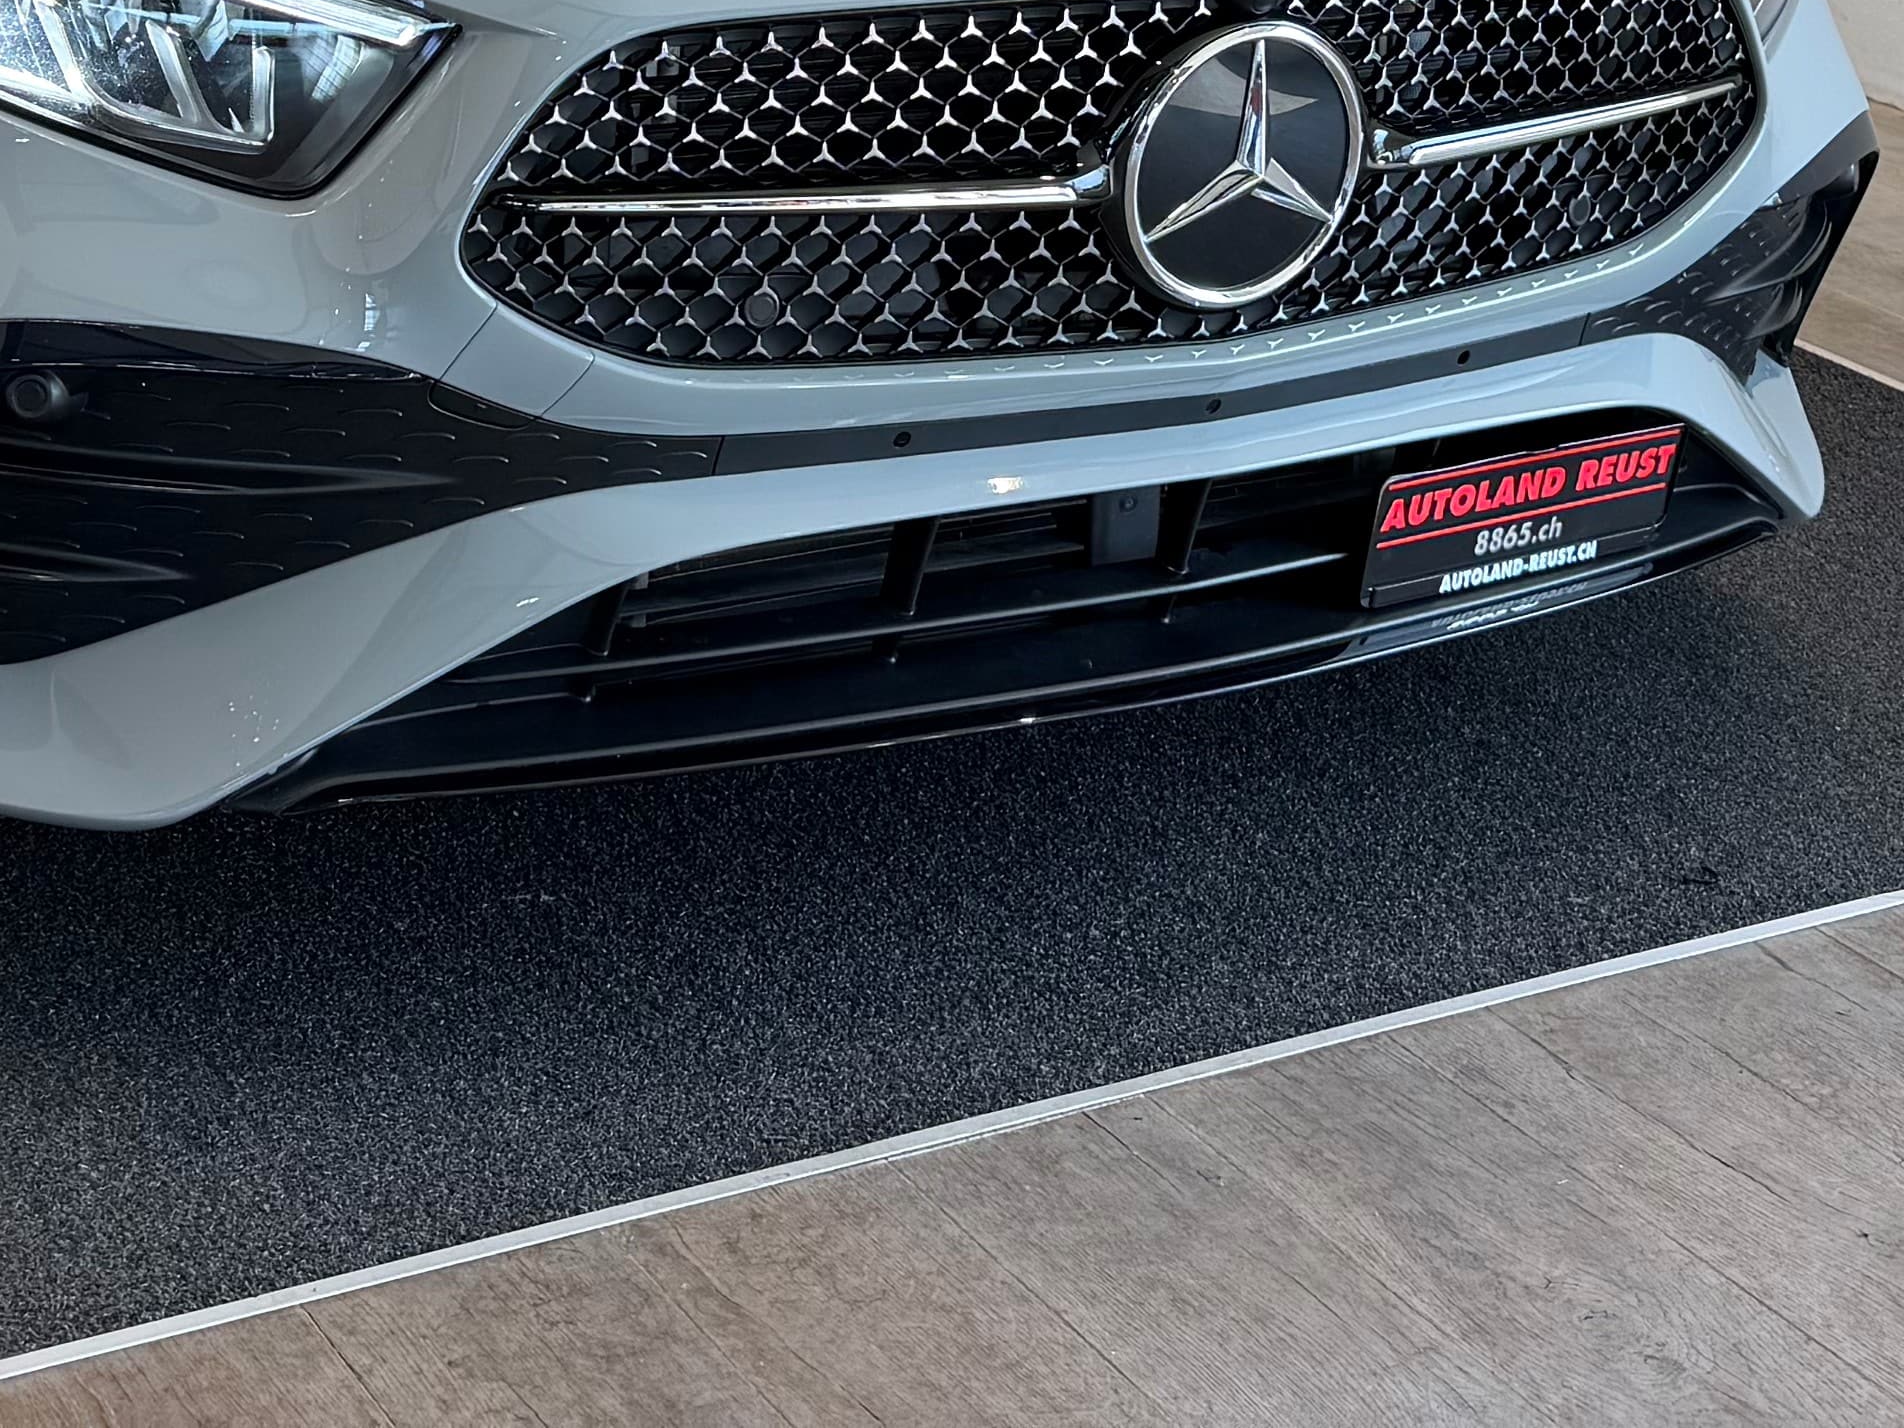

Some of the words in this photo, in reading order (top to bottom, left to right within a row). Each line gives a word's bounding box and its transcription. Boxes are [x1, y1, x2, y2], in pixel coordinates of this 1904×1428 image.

[1379, 466, 1567, 534] AUTOLAND
[1574, 443, 1677, 493] REUST
[1474, 515, 1564, 556] 8865.ch
[1438, 539, 1598, 595] AUTOLAND-REUST.CH
